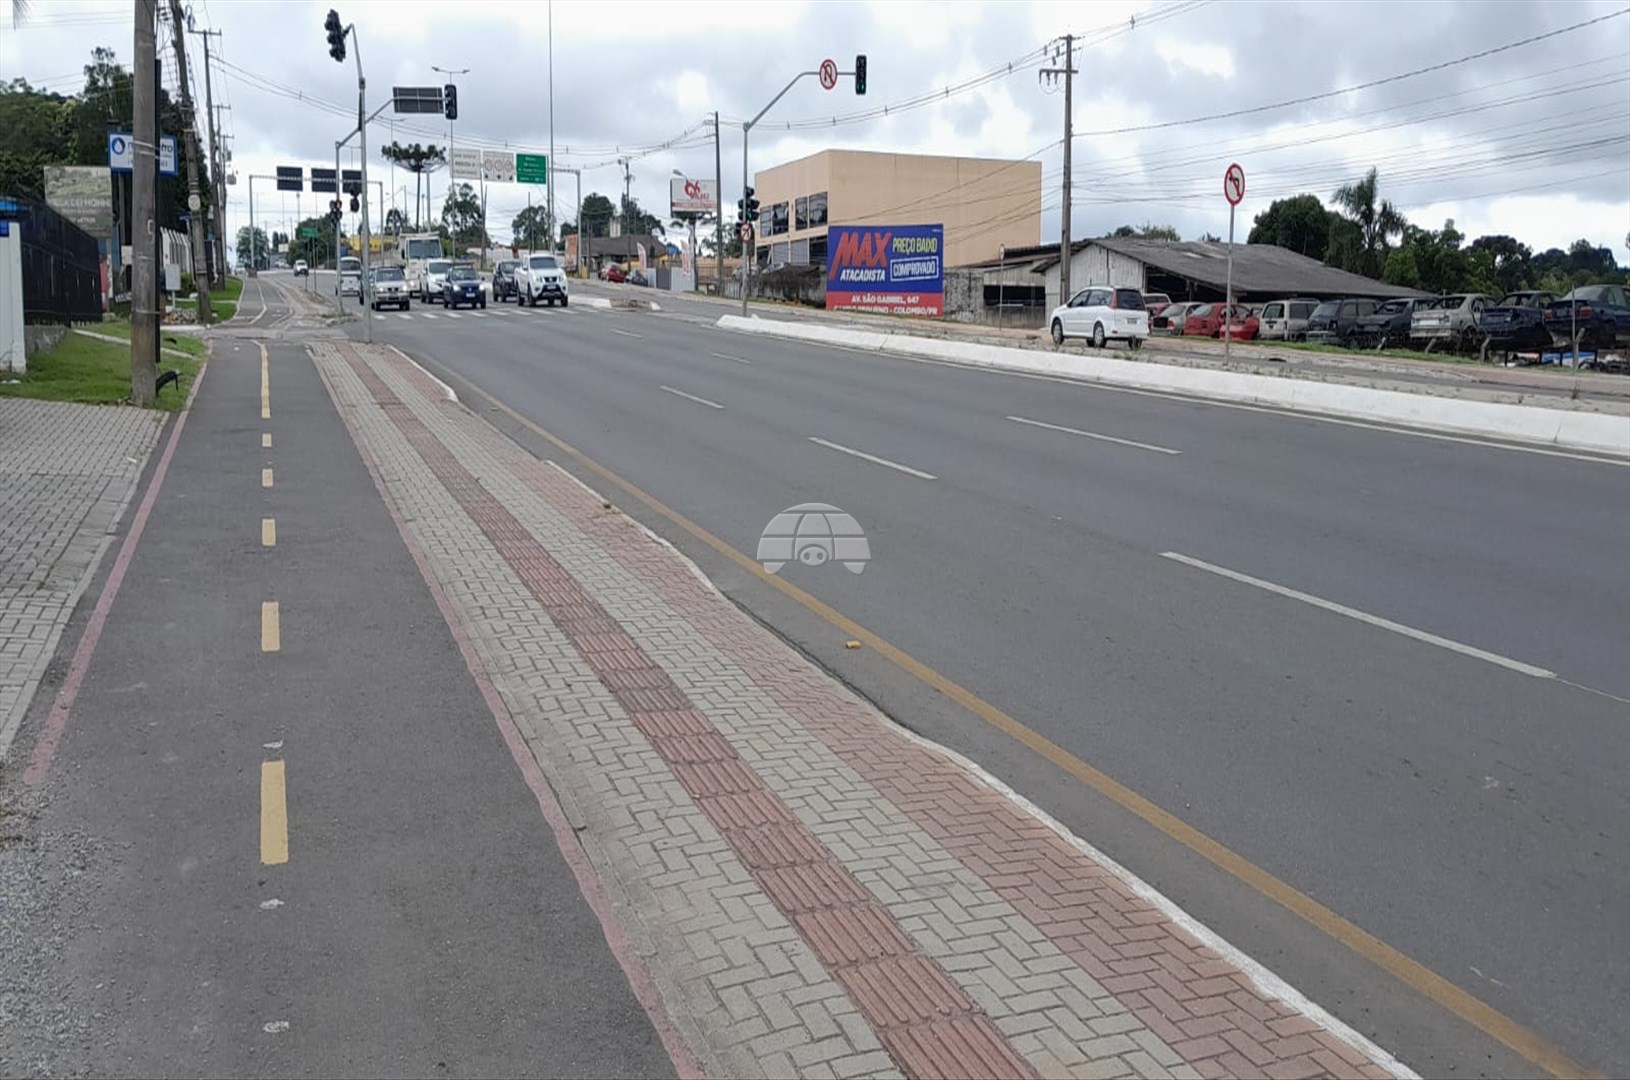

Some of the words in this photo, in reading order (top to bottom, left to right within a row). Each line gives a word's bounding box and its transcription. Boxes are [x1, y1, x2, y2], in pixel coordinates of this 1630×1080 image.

[892, 237, 915, 255] PREÇO
[916, 237, 938, 252] BAIXO
[828, 232, 891, 280] MAX
[840, 269, 885, 282] ATACADISTA
[893, 261, 936, 277] COMPROVADO
